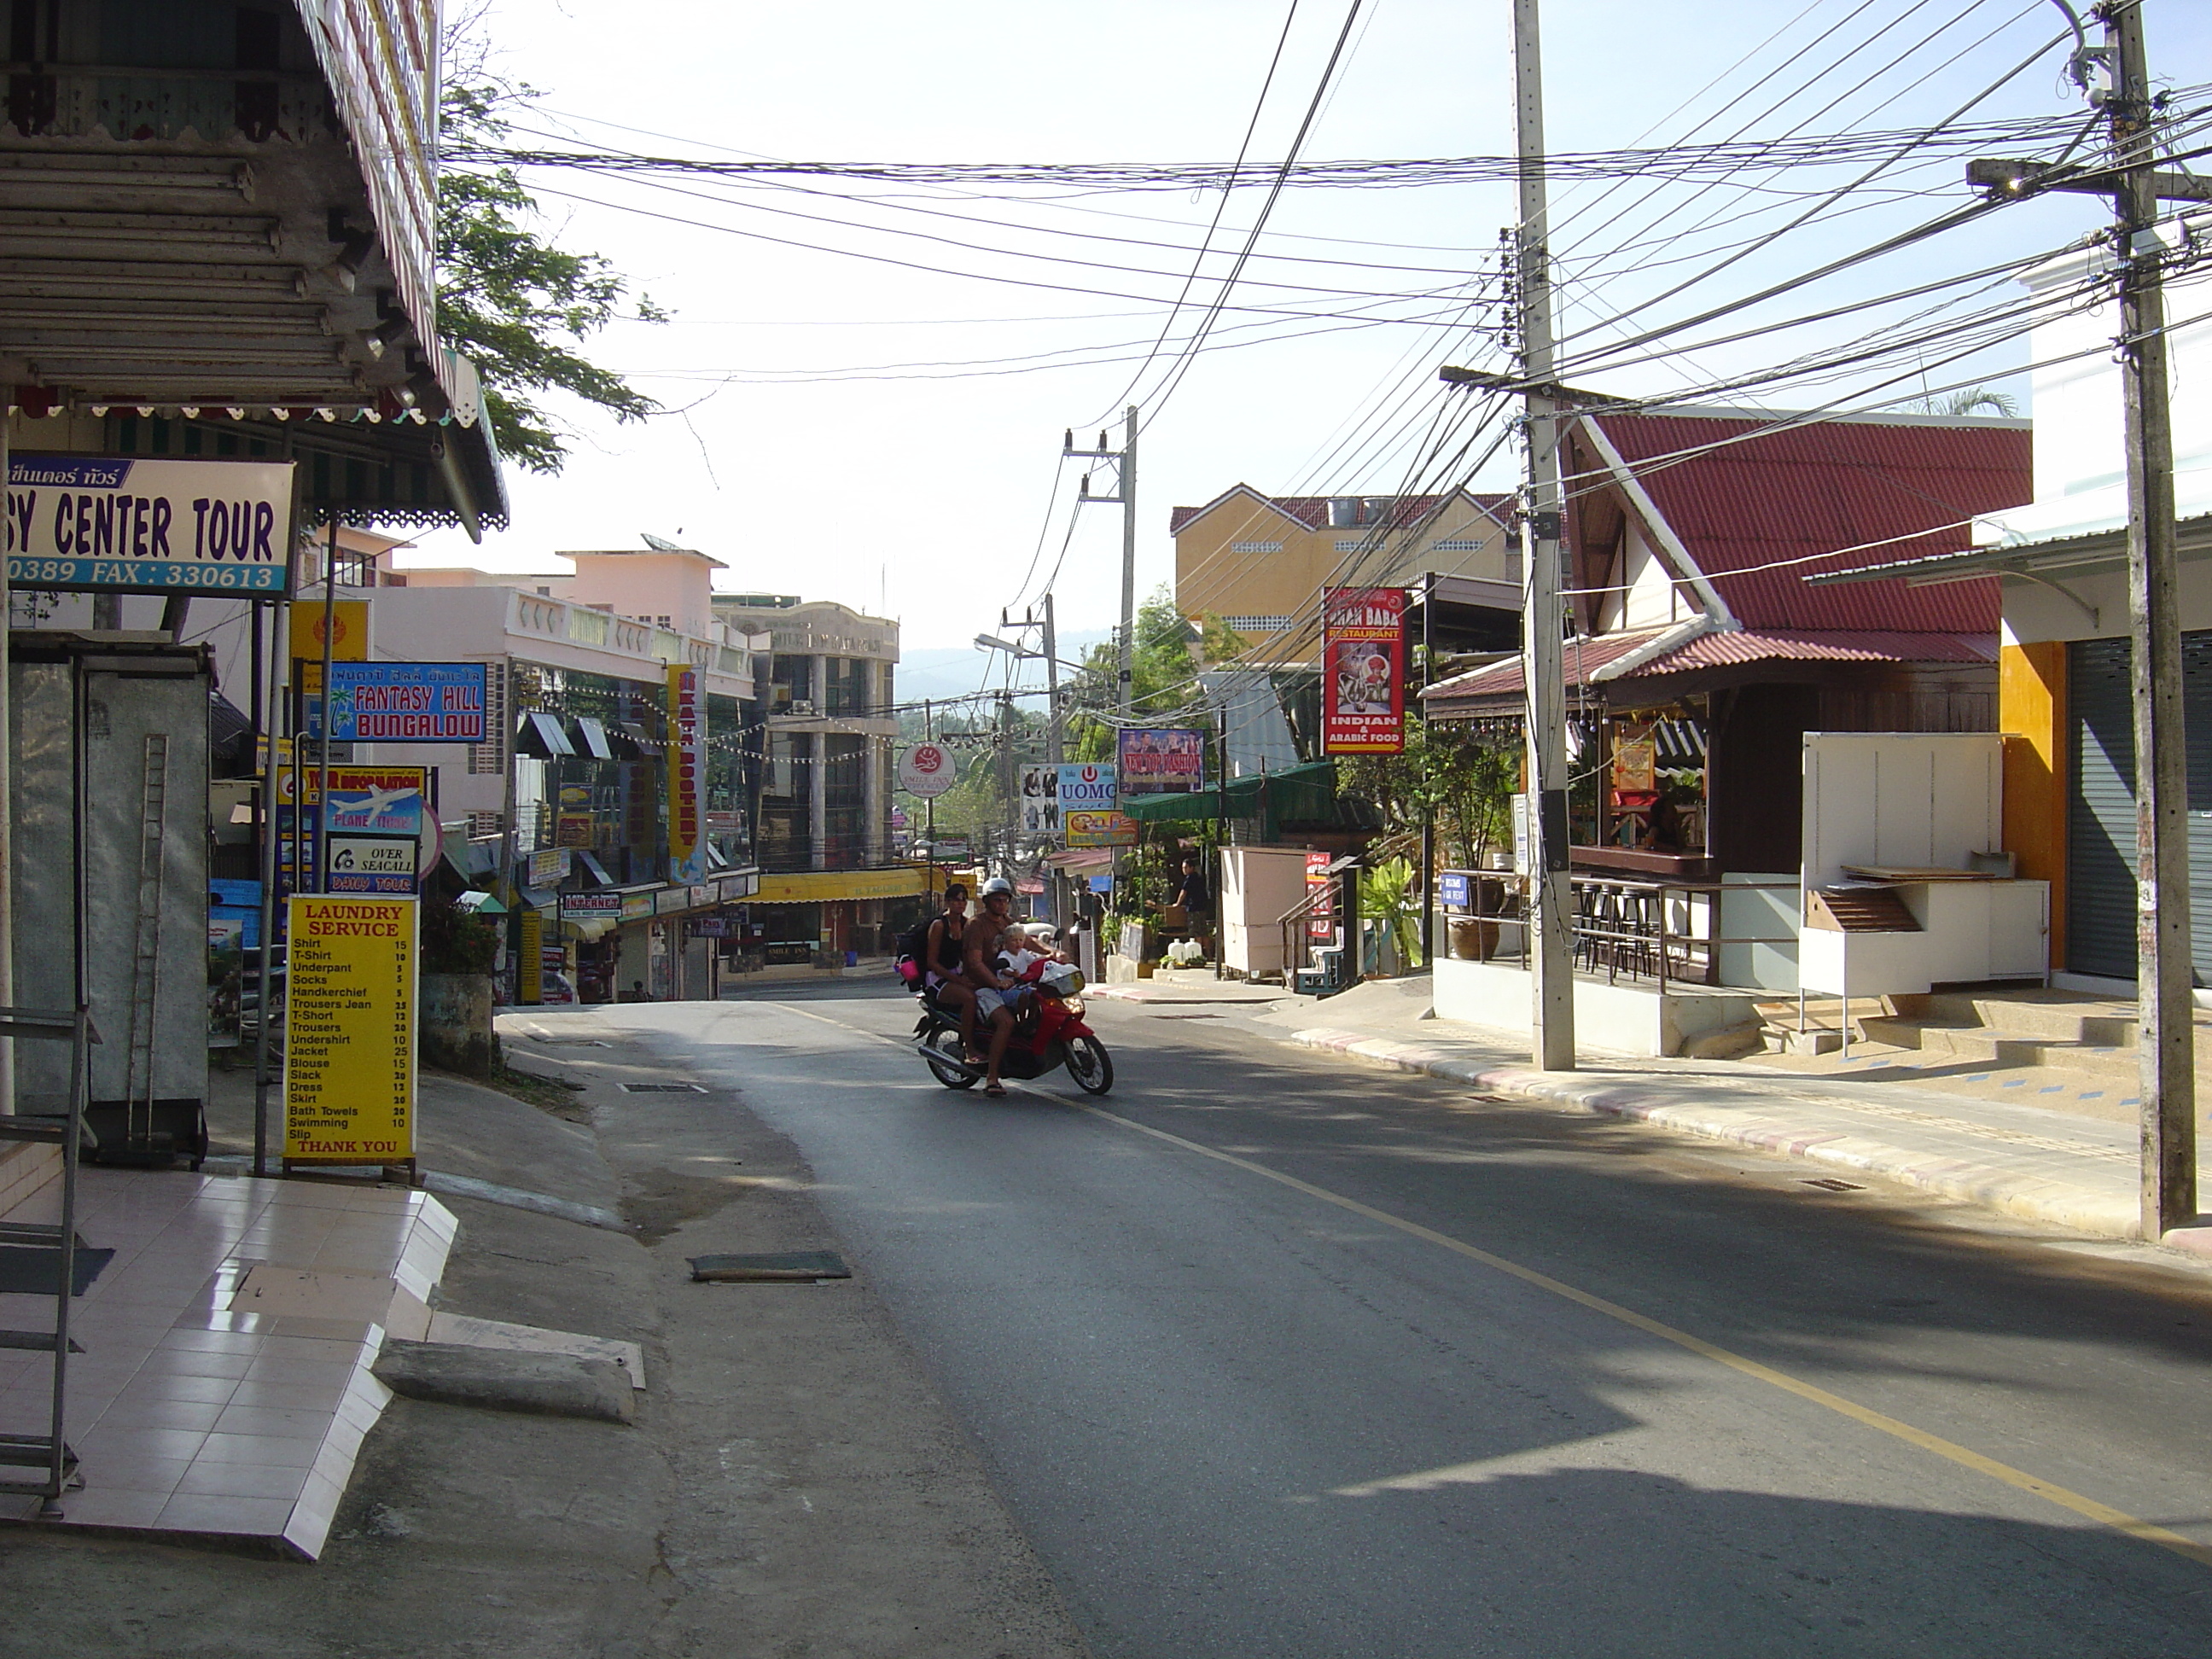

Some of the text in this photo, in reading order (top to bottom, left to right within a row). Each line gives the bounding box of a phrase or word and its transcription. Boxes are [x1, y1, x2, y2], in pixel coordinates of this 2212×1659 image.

[55, 492, 172, 557] CENTER
[193, 498, 274, 562] TOUR
[91, 563, 141, 583] FAX
[166, 565, 272, 588] 330613
[1365, 606, 1400, 627] BABA
[1329, 629, 1400, 638] RESTAURANT
[355, 685, 481, 711] FANTASY HILL
[356, 713, 481, 737] BUNGALOW
[1330, 716, 1398, 725] INDIAN
[1359, 725, 1369, 734] &
[1329, 733, 1400, 742] ARABIC FOOD
[1124, 754, 1201, 772] NEW TOP FASHION
[334, 814, 369, 828] PLANE
[371, 848, 403, 859] OVER
[332, 876, 411, 891] DAILY TOUR
[565, 899, 619, 909] INTERNET
[306, 905, 404, 920] LAUNDRY
[308, 921, 399, 937] SERVICE
[294, 939, 321, 948] Shirt
[294, 951, 332, 960] T-Shirt
[293, 963, 352, 973] Underpant
[293, 975, 328, 984] Socks
[292, 987, 367, 997] Handkerchief
[293, 998, 341, 1009] Trousers
[345, 999, 372, 1009] Jean
[292, 1010, 334, 1020] T-Short
[292, 1022, 406, 1032] Trousers 20
[291, 1034, 406, 1045] Undershirt 10
[291, 1046, 408, 1057] Jacket 25
[290, 1058, 405, 1068] Blouse 15
[290, 1070, 322, 1080] Slack
[290, 1082, 405, 1091] Dress 12
[290, 1093, 406, 1104] Skirt 20
[289, 1106, 405, 1116] Bath Towels 20
[289, 1117, 405, 1130] Swimming 10
[288, 1129, 311, 1140] Slip
[297, 1140, 398, 1153] THANK YOU
